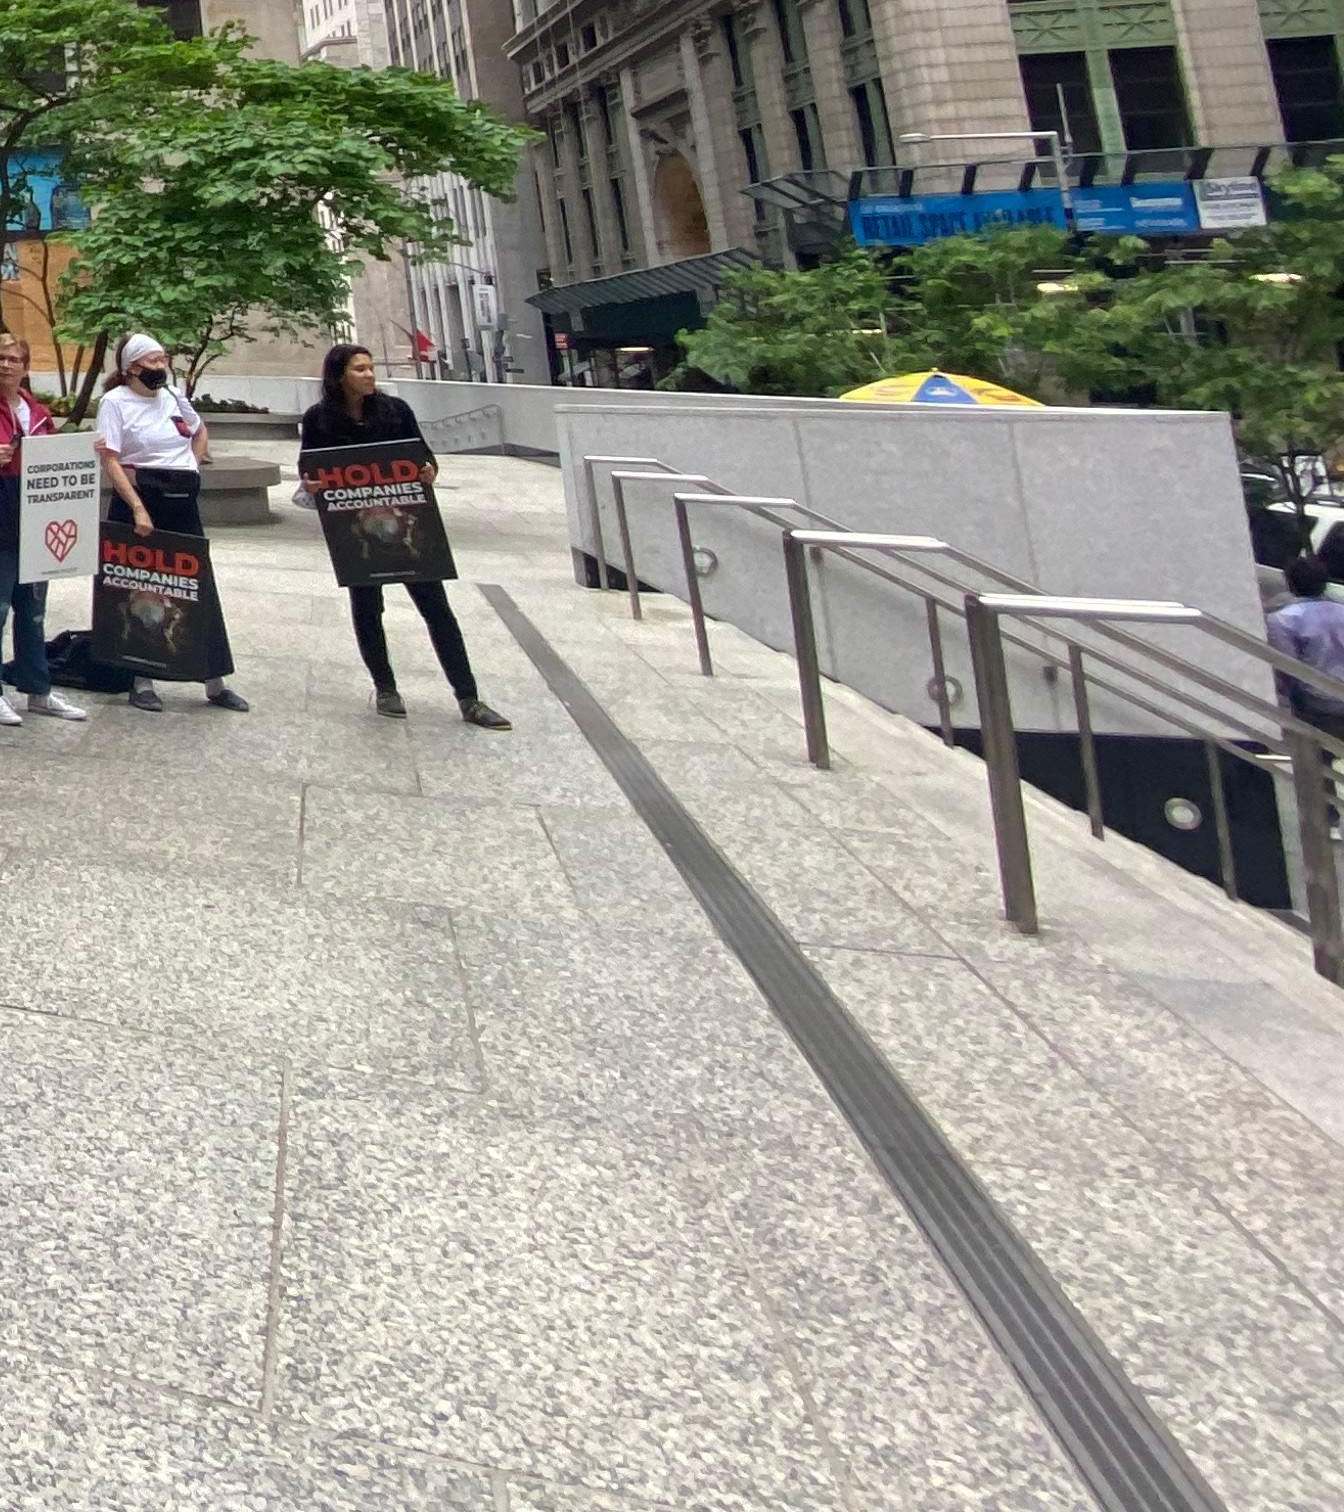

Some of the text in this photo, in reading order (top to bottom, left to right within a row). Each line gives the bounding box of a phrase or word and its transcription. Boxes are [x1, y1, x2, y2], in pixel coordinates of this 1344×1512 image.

[862, 214, 912, 238] RETAIL
[27, 460, 96, 474] CORPORATIONS
[318, 459, 419, 489] HOLD
[27, 472, 96, 490] NEED TO BE
[324, 481, 423, 501] COMPANIES
[27, 489, 95, 504] TRANSPARENT
[327, 494, 427, 512] ACCOUNTABLE
[103, 539, 199, 576] HOLD
[103, 563, 199, 590] COMPANIES
[102, 576, 200, 602] ACCOUNTABLE
